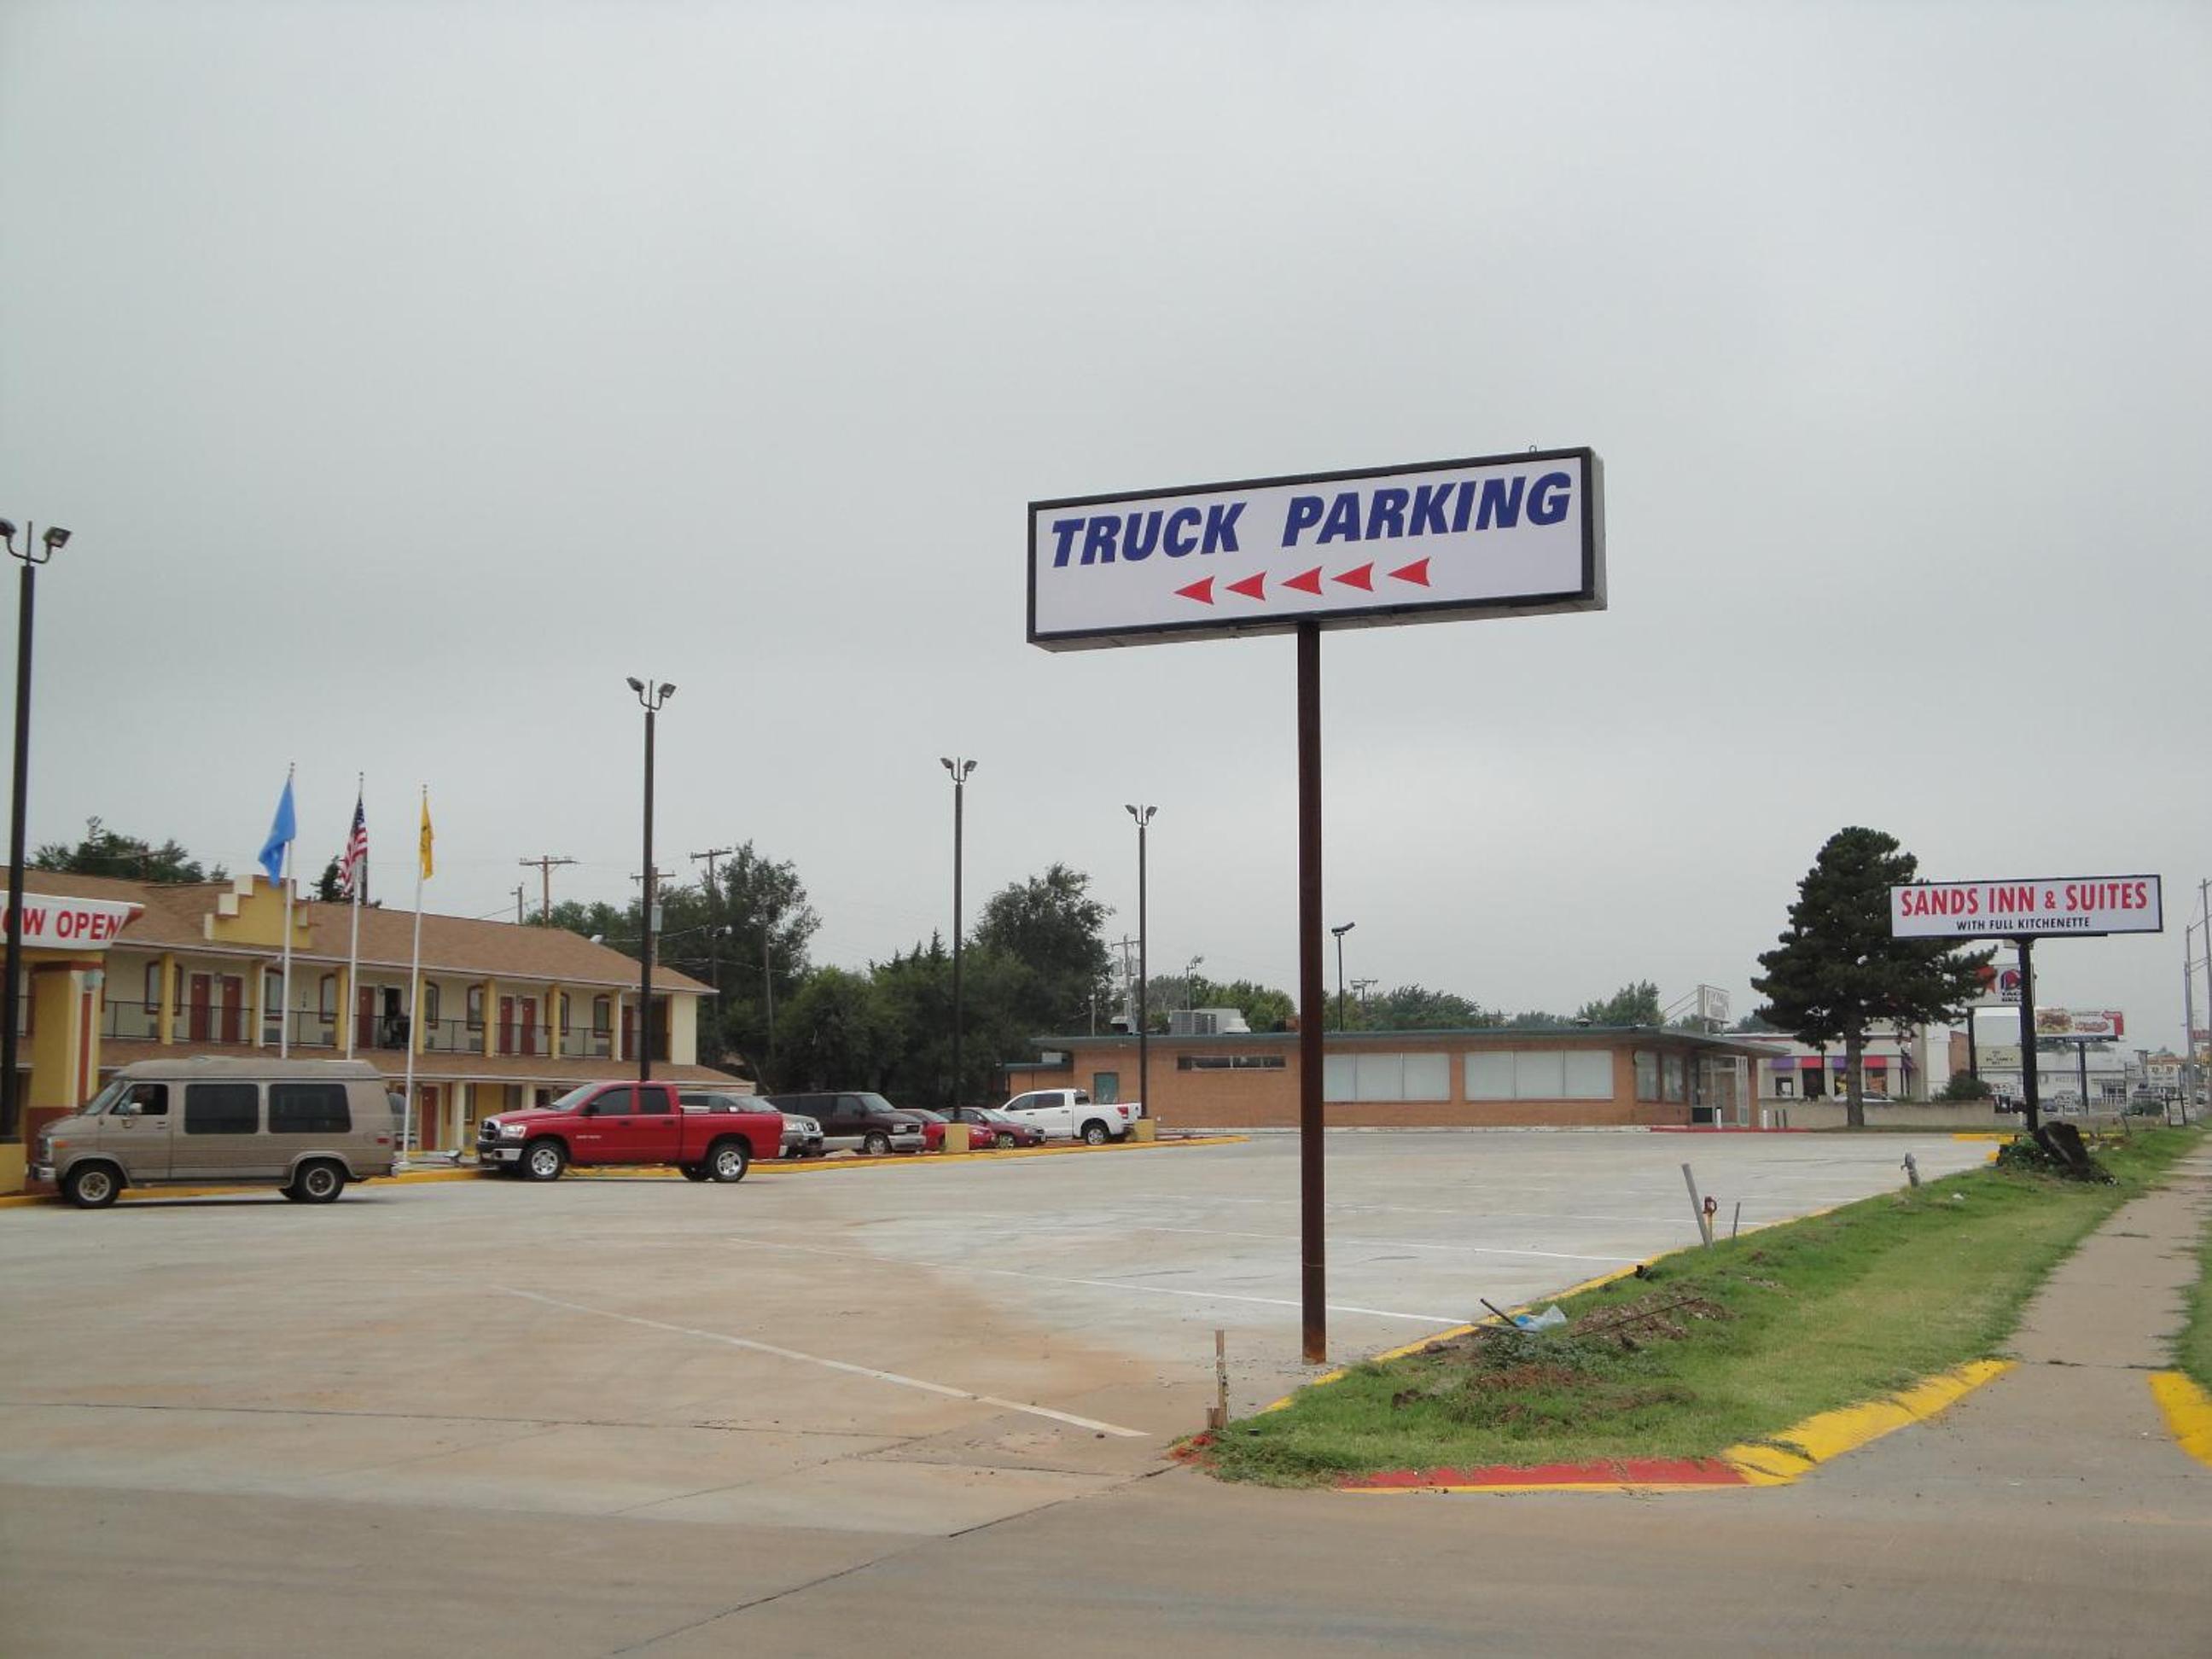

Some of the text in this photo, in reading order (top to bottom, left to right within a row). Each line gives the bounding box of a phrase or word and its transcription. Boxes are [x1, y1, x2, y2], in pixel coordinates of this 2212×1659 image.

[1052, 472, 1571, 568] TRUCK PARKING
[1901, 882, 2147, 917] SANDS INN & SUITES
[56, 911, 122, 940] OPEN
[1956, 917, 2090, 931] WITH FULL KITCHENETTE
